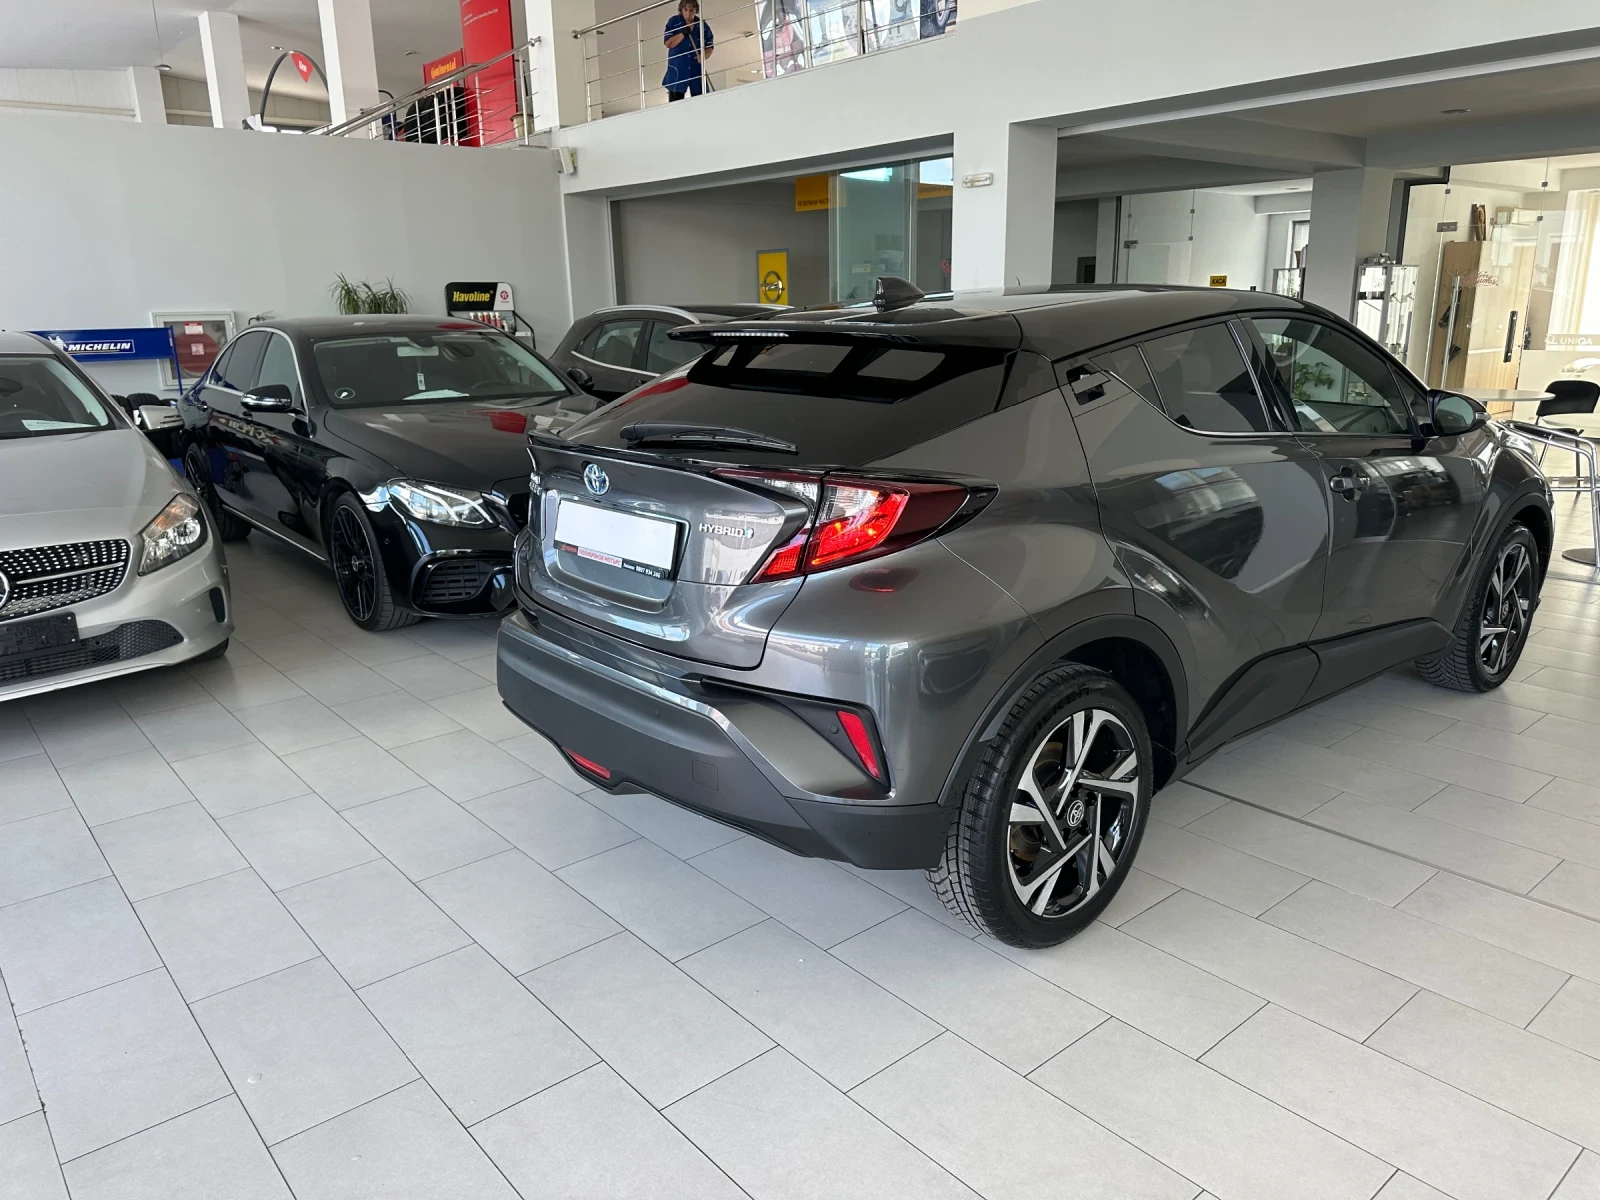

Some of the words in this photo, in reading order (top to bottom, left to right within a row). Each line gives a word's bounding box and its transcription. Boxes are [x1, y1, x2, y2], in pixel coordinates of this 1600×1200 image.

[452, 291, 490, 302] Havoline
[1560, 337, 1593, 346] UNIQA
[67, 342, 131, 352] MICHELIN
[698, 522, 745, 538] HYBRID
